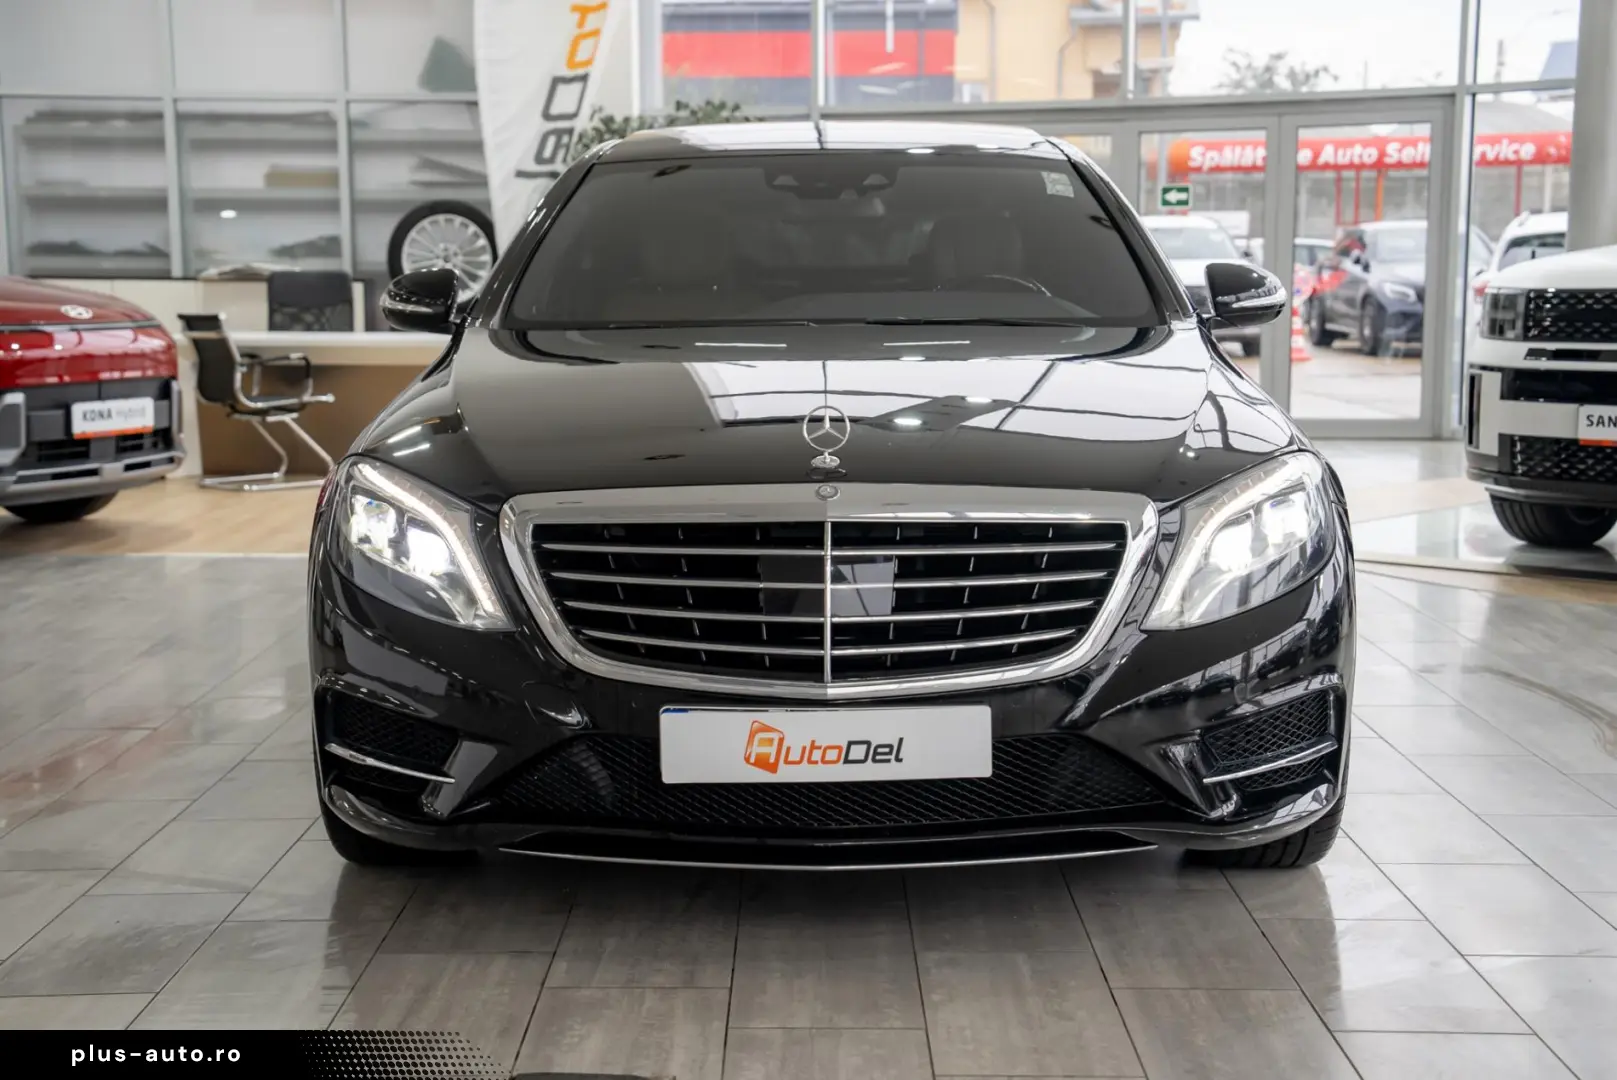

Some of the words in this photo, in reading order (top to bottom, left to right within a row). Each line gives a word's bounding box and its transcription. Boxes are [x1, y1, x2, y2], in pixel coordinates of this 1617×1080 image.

[1317, 143, 1378, 165] Auto
[82, 408, 113, 421] KONA
[1586, 414, 1617, 428] SAN
[744, 720, 904, 774] AutoDel
